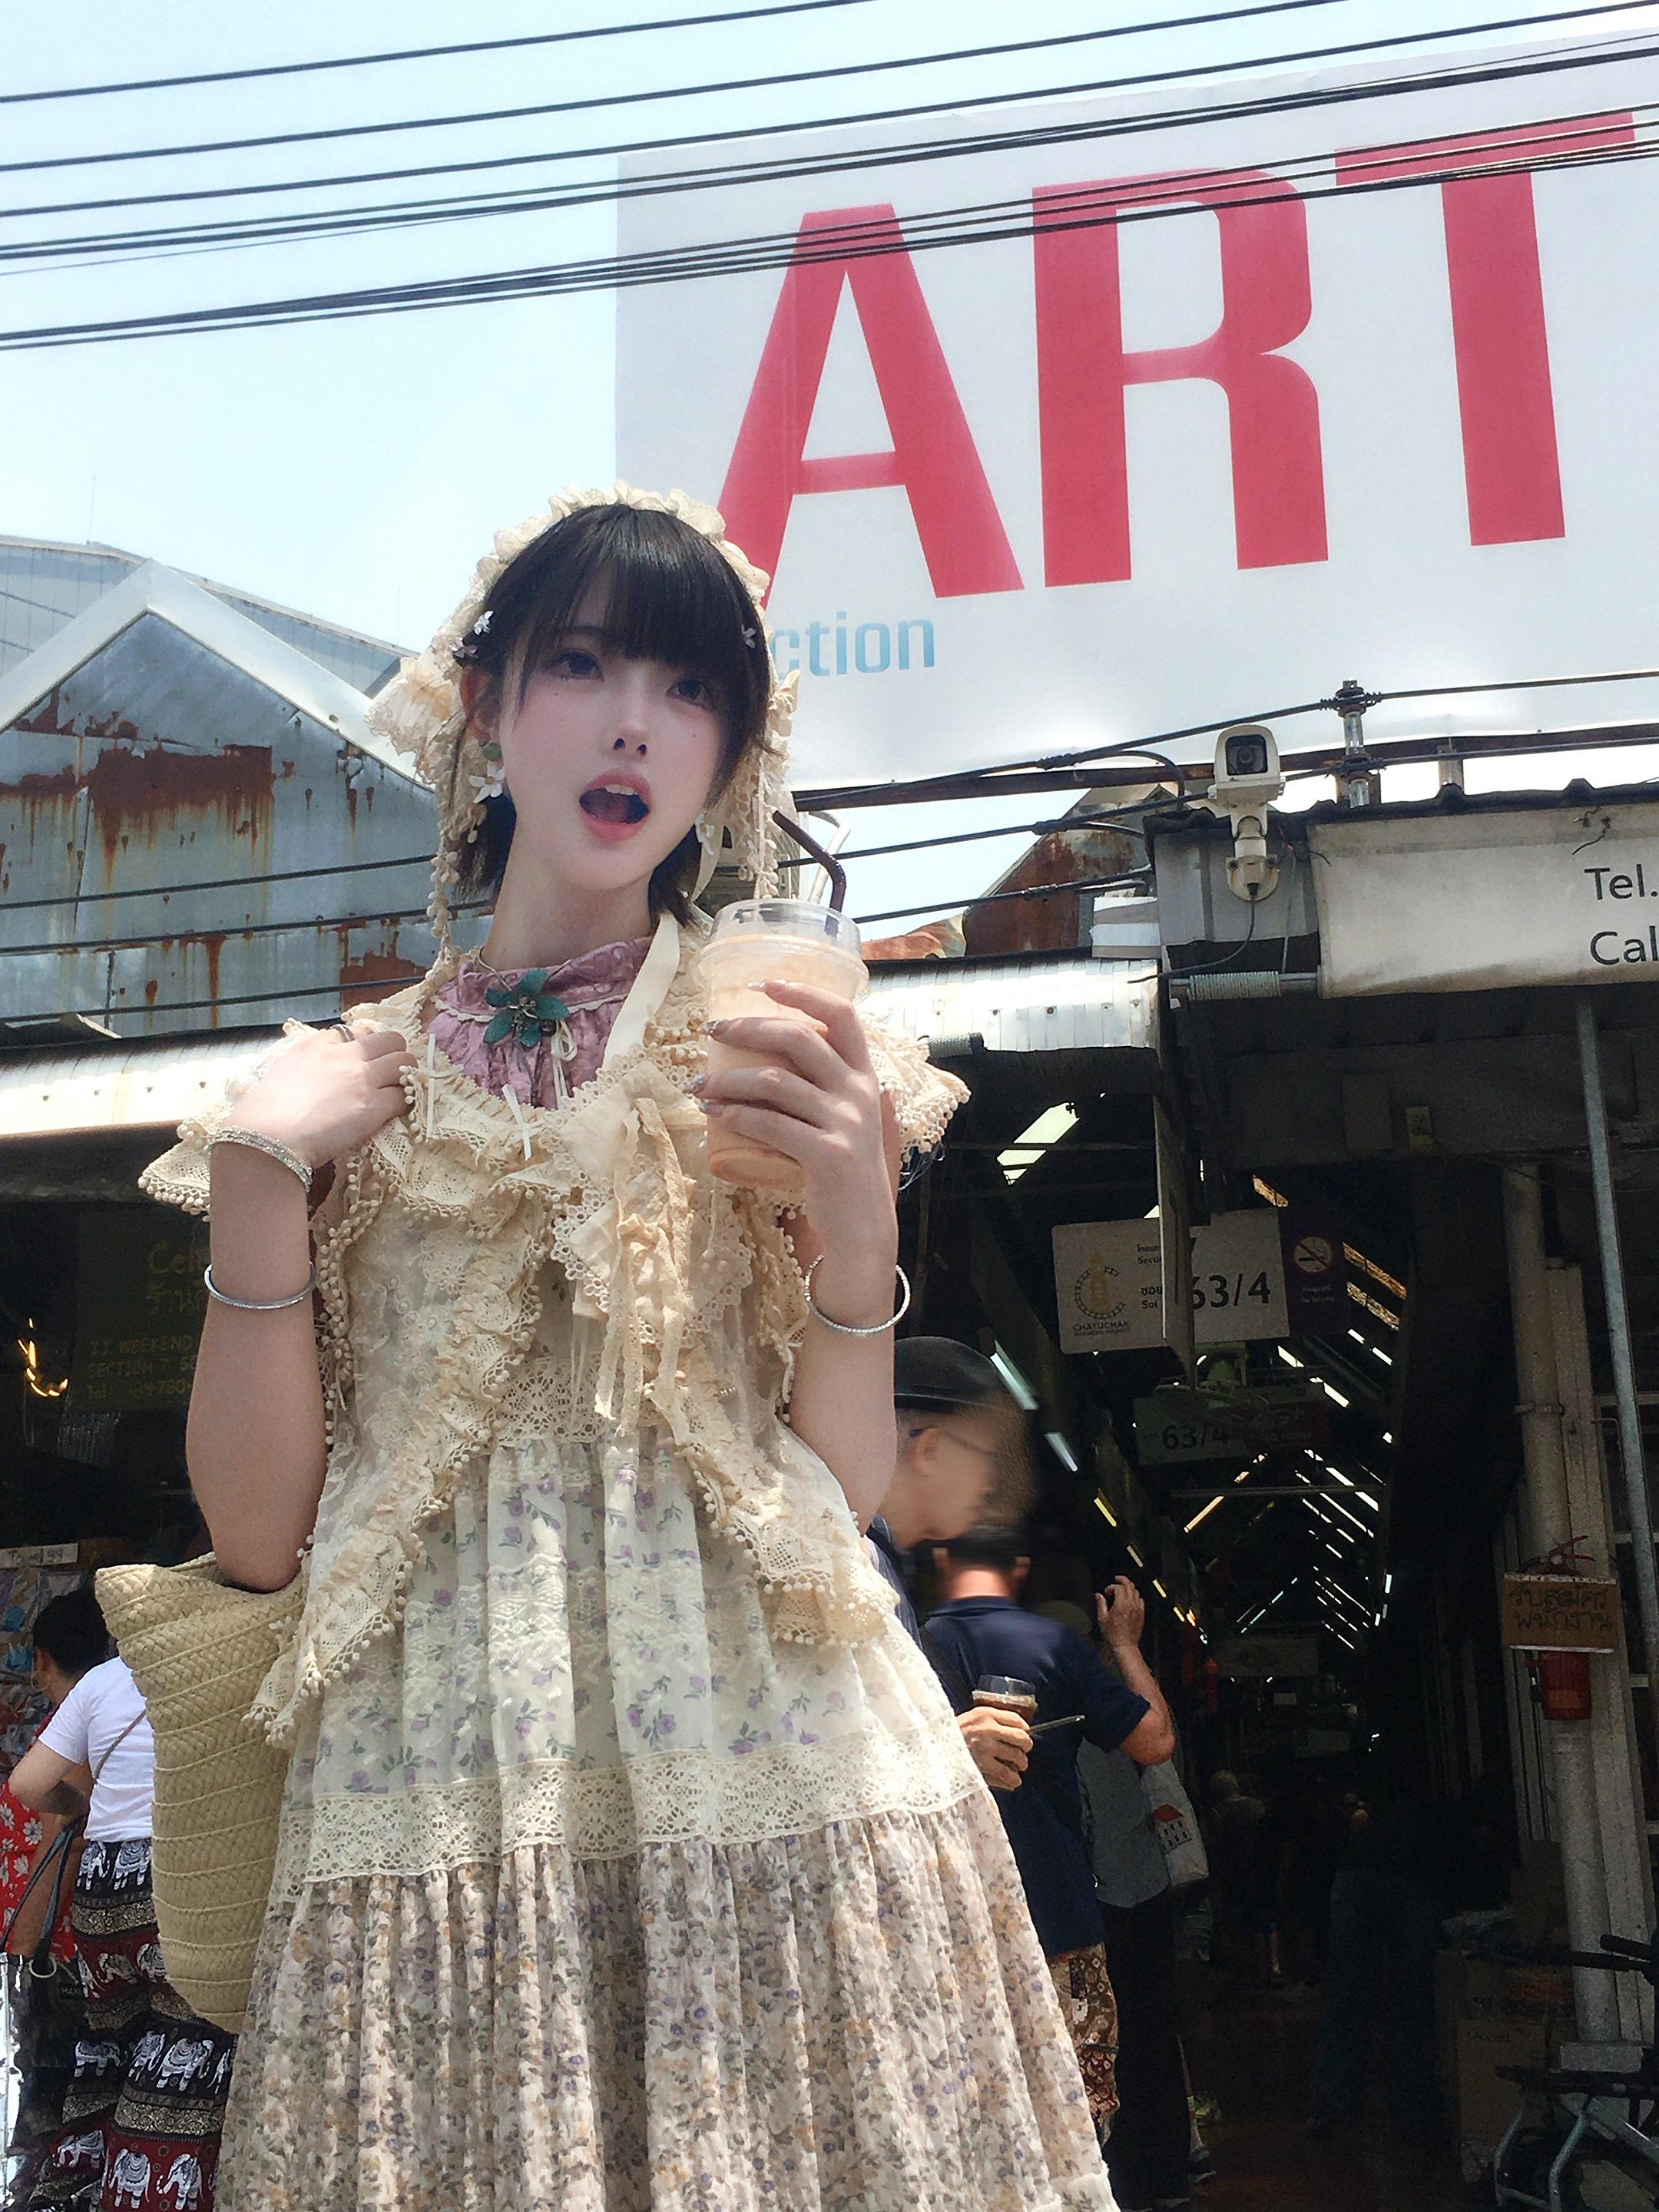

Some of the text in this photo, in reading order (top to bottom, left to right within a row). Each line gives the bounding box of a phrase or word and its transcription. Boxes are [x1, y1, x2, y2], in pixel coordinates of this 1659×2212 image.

[719, 111, 1633, 607] ART
[772, 611, 935, 680] ction
[1584, 863, 1658, 900] Tel.
[1590, 925, 1659, 965] Cal
[1142, 1300, 1157, 1310] Soi
[1191, 1271, 1270, 1310] 63/4
[1072, 1320, 1131, 1332] CHATUCHAK
[1162, 1424, 1230, 1450] 63/4
